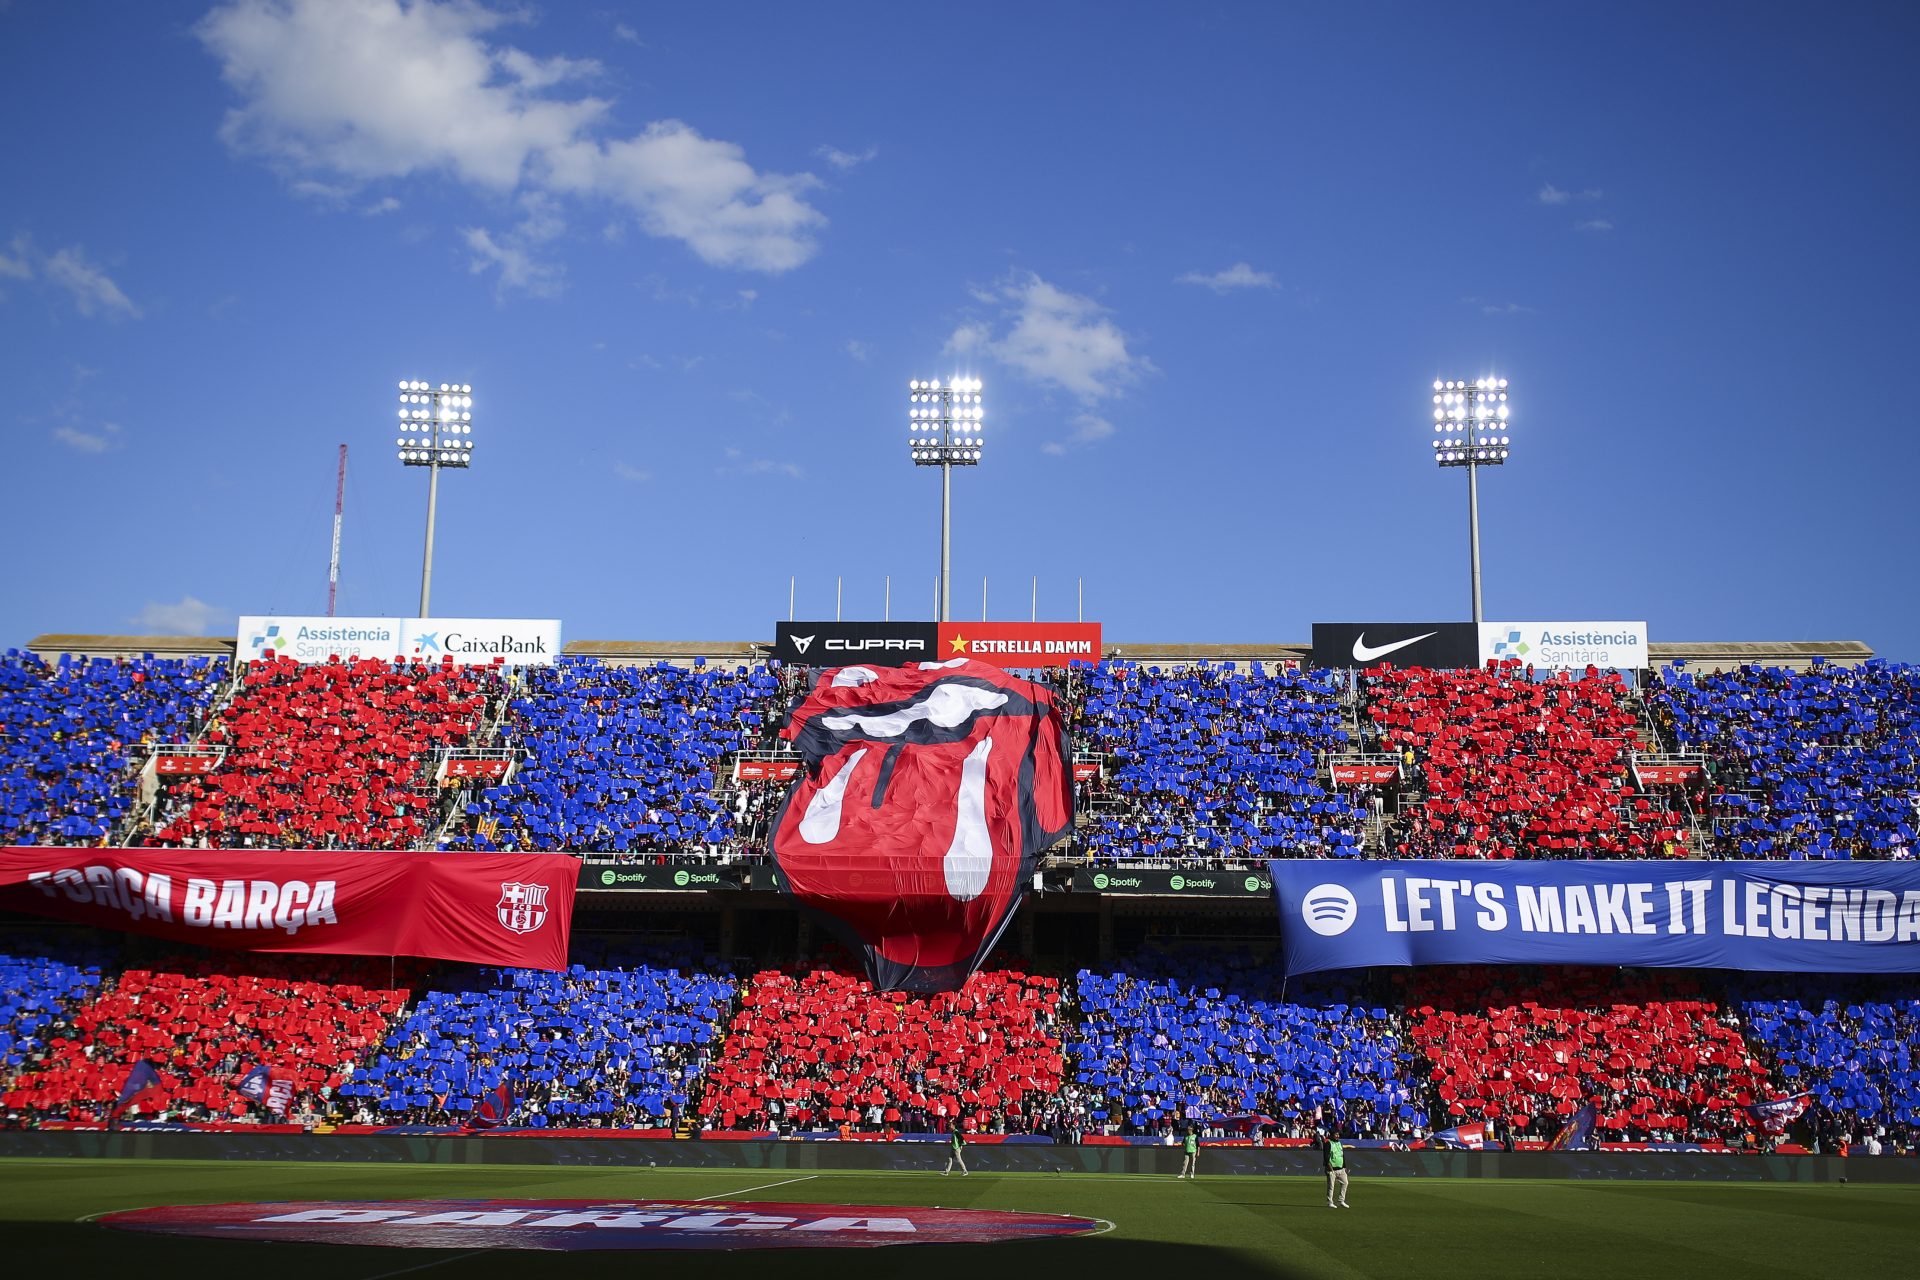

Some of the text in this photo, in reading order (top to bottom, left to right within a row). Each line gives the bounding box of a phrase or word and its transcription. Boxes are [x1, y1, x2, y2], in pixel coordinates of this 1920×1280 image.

[296, 626, 390, 642] Assistència
[1540, 631, 1638, 646] Assistència
[296, 642, 361, 658] Sanitària
[444, 633, 546, 653] CaixaBank
[825, 639, 925, 650] CUPRA
[971, 640, 1091, 653] ESTRELLA DAMM
[1540, 647, 1609, 662] Sanitària
[617, 873, 647, 883] Spotify
[690, 873, 720, 883] Spotify
[1110, 877, 1142, 888] Spotify
[1186, 879, 1216, 889] Spotify
[28, 866, 338, 935] FORÇA BARÇA
[513, 903, 531, 911] FCB
[1381, 877, 1508, 932] LET'S
[1515, 883, 1658, 934] MAKE
[1664, 879, 1712, 935] IT
